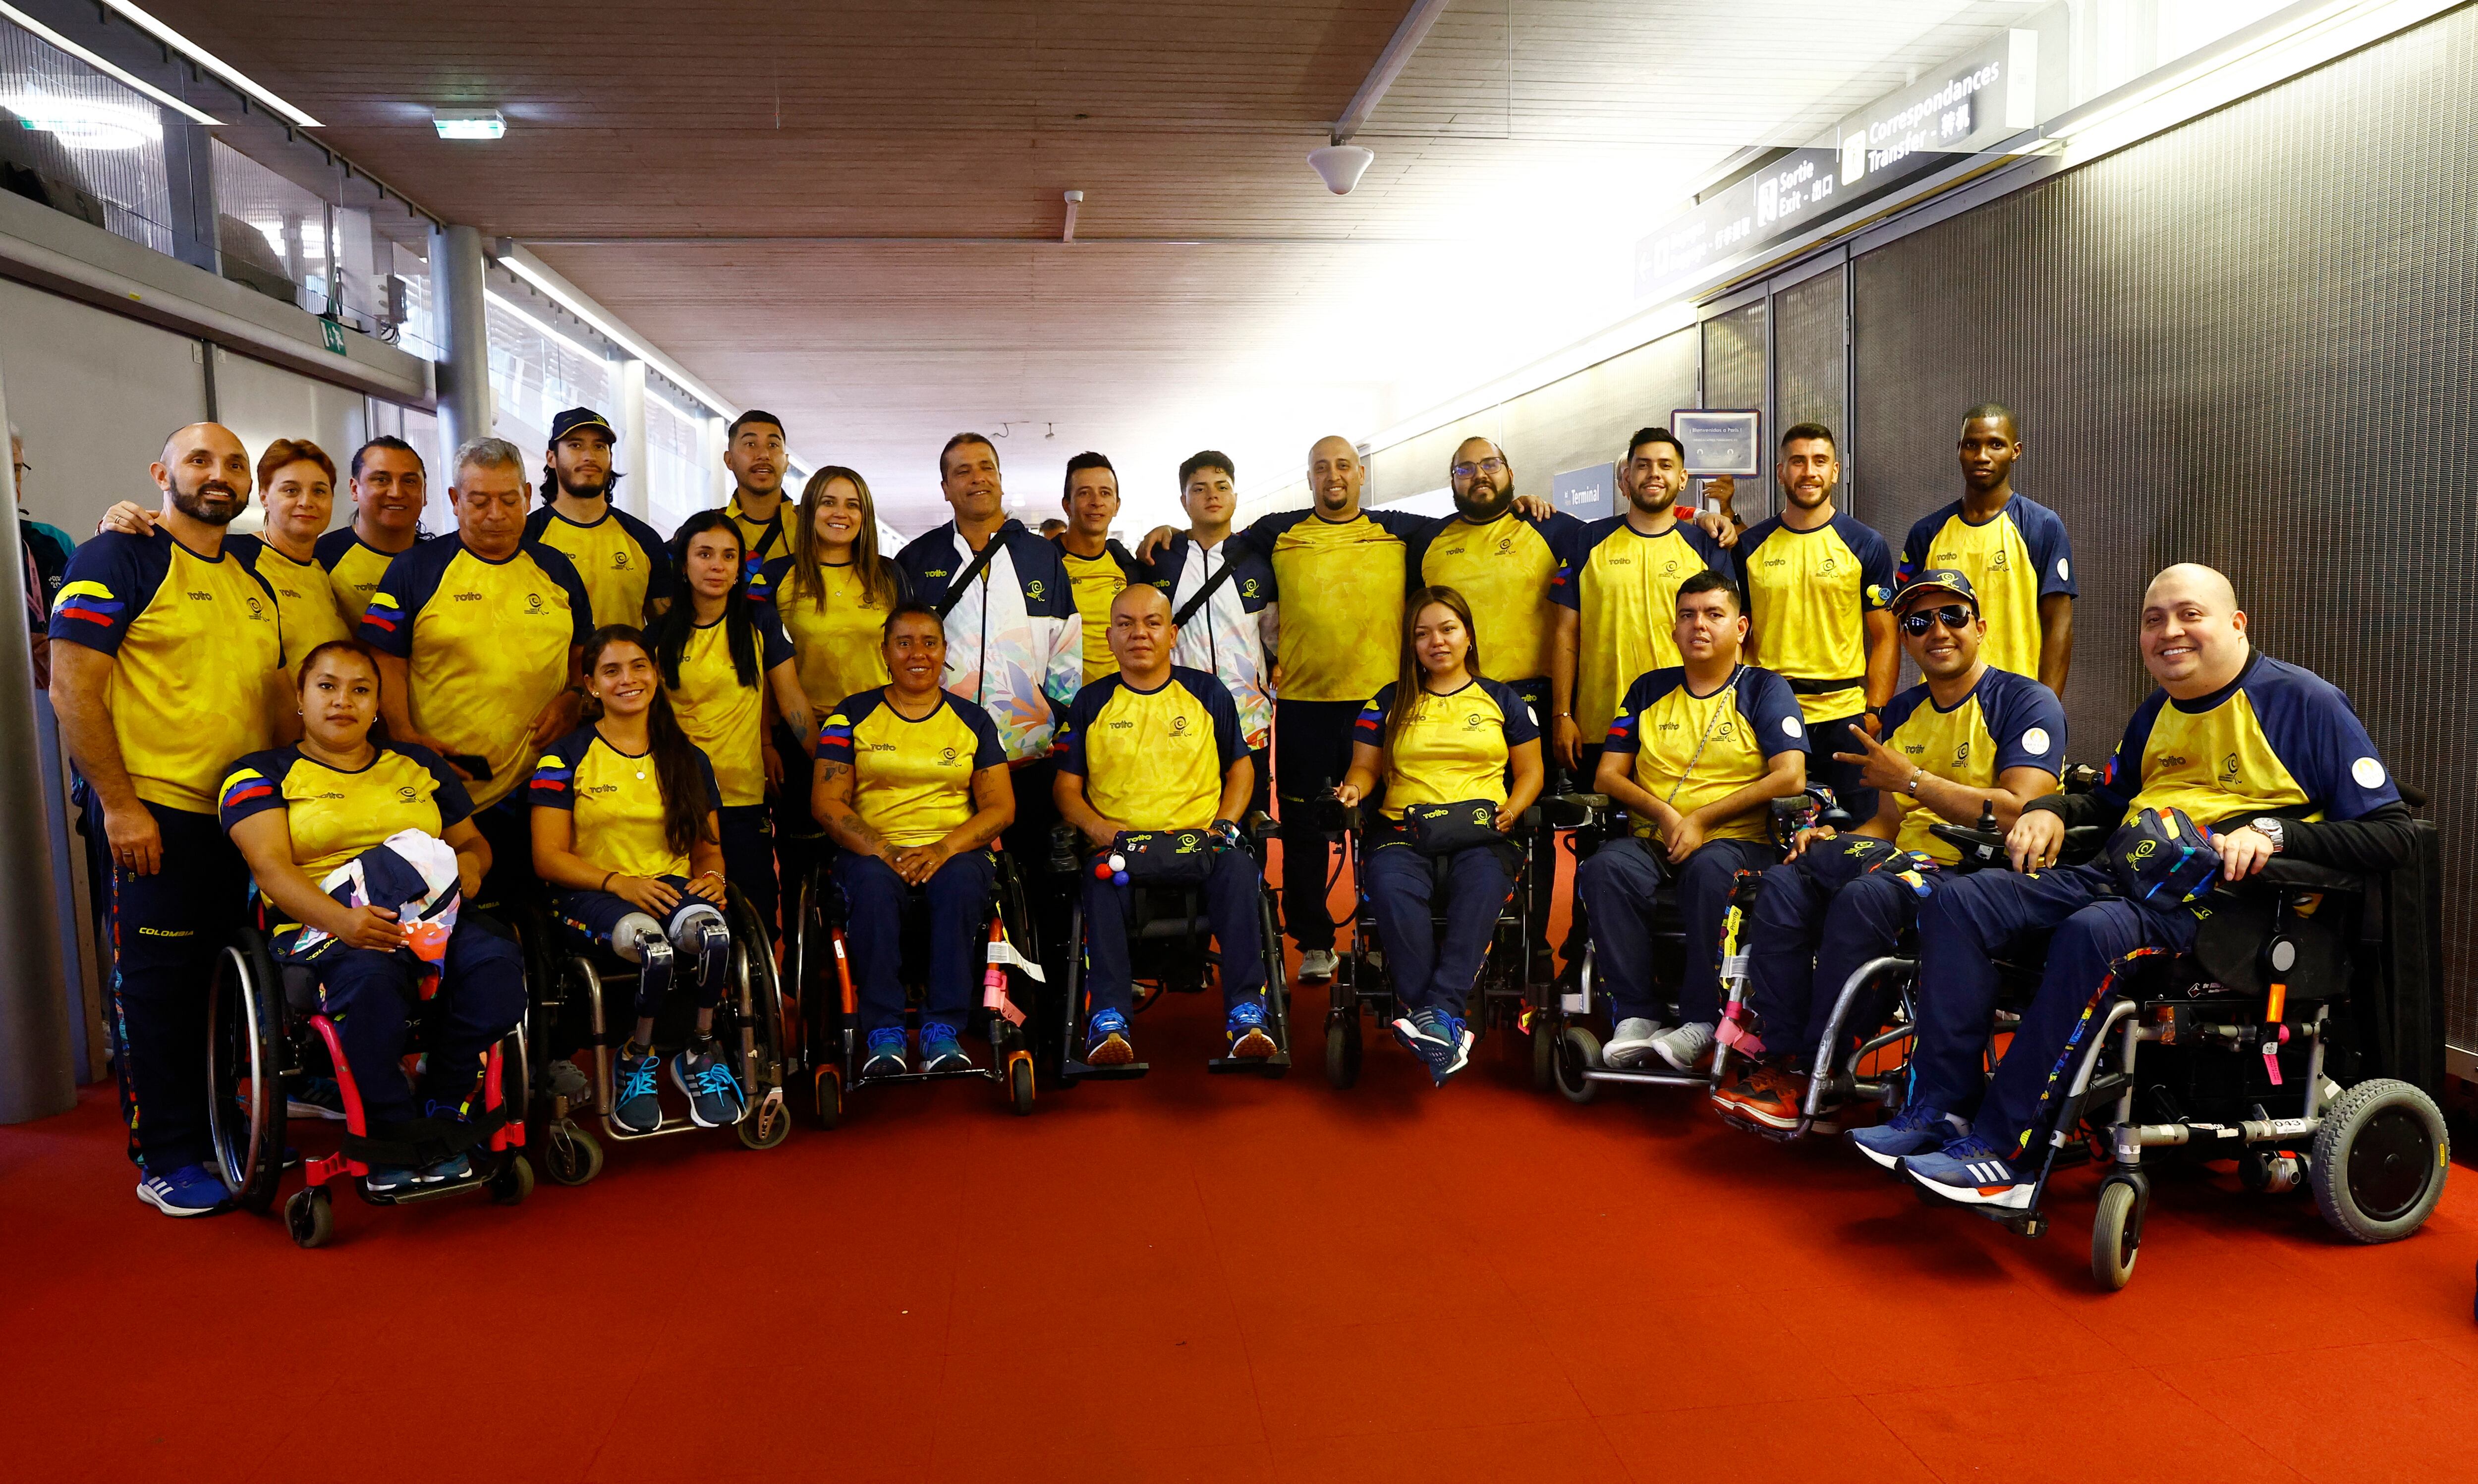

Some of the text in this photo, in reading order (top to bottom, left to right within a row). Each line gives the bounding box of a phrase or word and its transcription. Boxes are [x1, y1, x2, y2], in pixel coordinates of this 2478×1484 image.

[1869, 61, 1999, 144] Correspondances
[1868, 129, 1926, 173] Transfer
[1780, 160, 1814, 193] Sortie
[1779, 191, 1801, 218] Exit
[1812, 174, 1833, 202] 出口
[1571, 483, 1599, 505] Terminal
[139, 927, 194, 937] COLOMBIA
[1729, 910, 1739, 931] Priority
